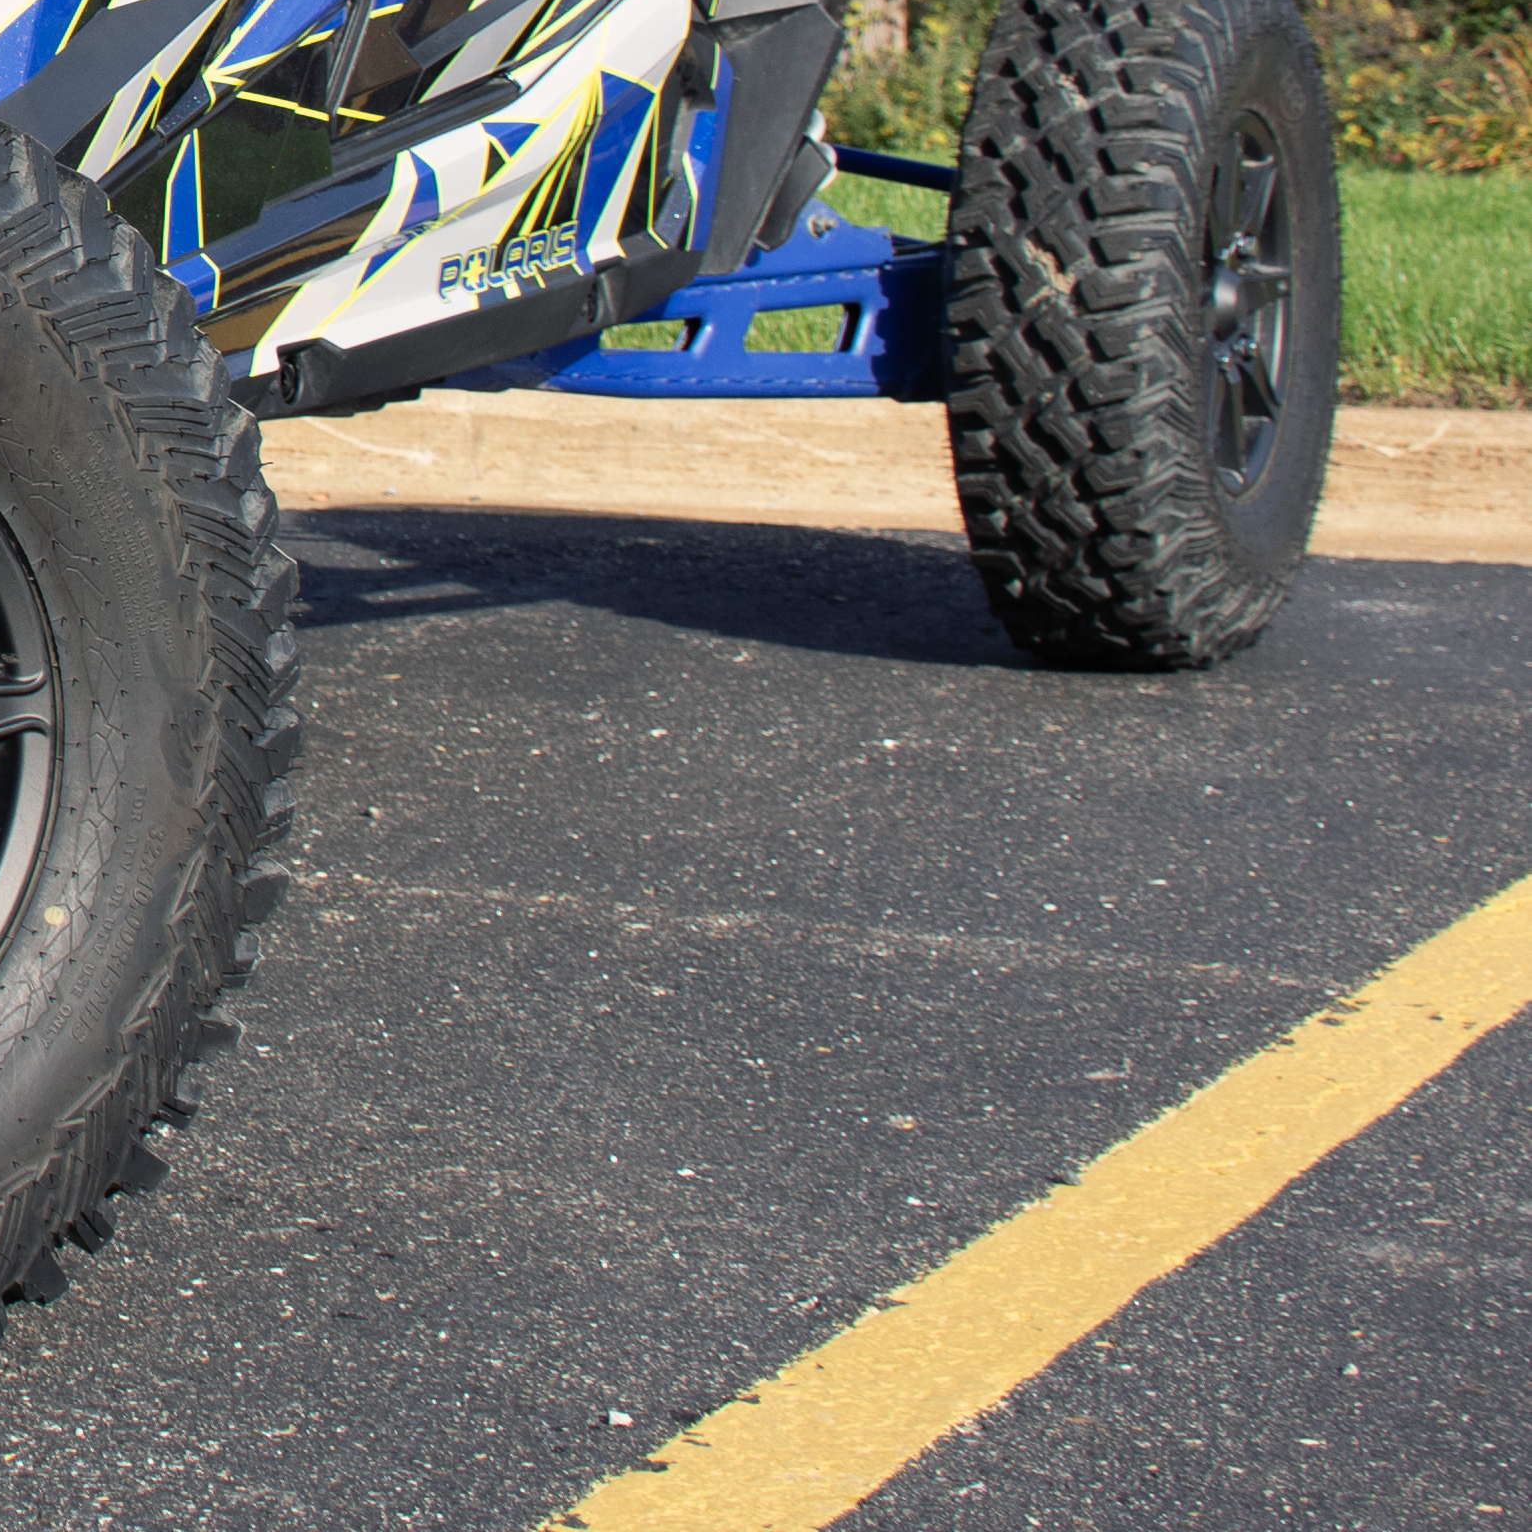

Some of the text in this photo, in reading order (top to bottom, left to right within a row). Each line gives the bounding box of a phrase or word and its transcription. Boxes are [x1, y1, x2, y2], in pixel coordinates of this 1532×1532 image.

[437, 221, 577, 302] POLARIS
[36, 783, 147, 1052] FOR ATV OR UTV USE ONLY
